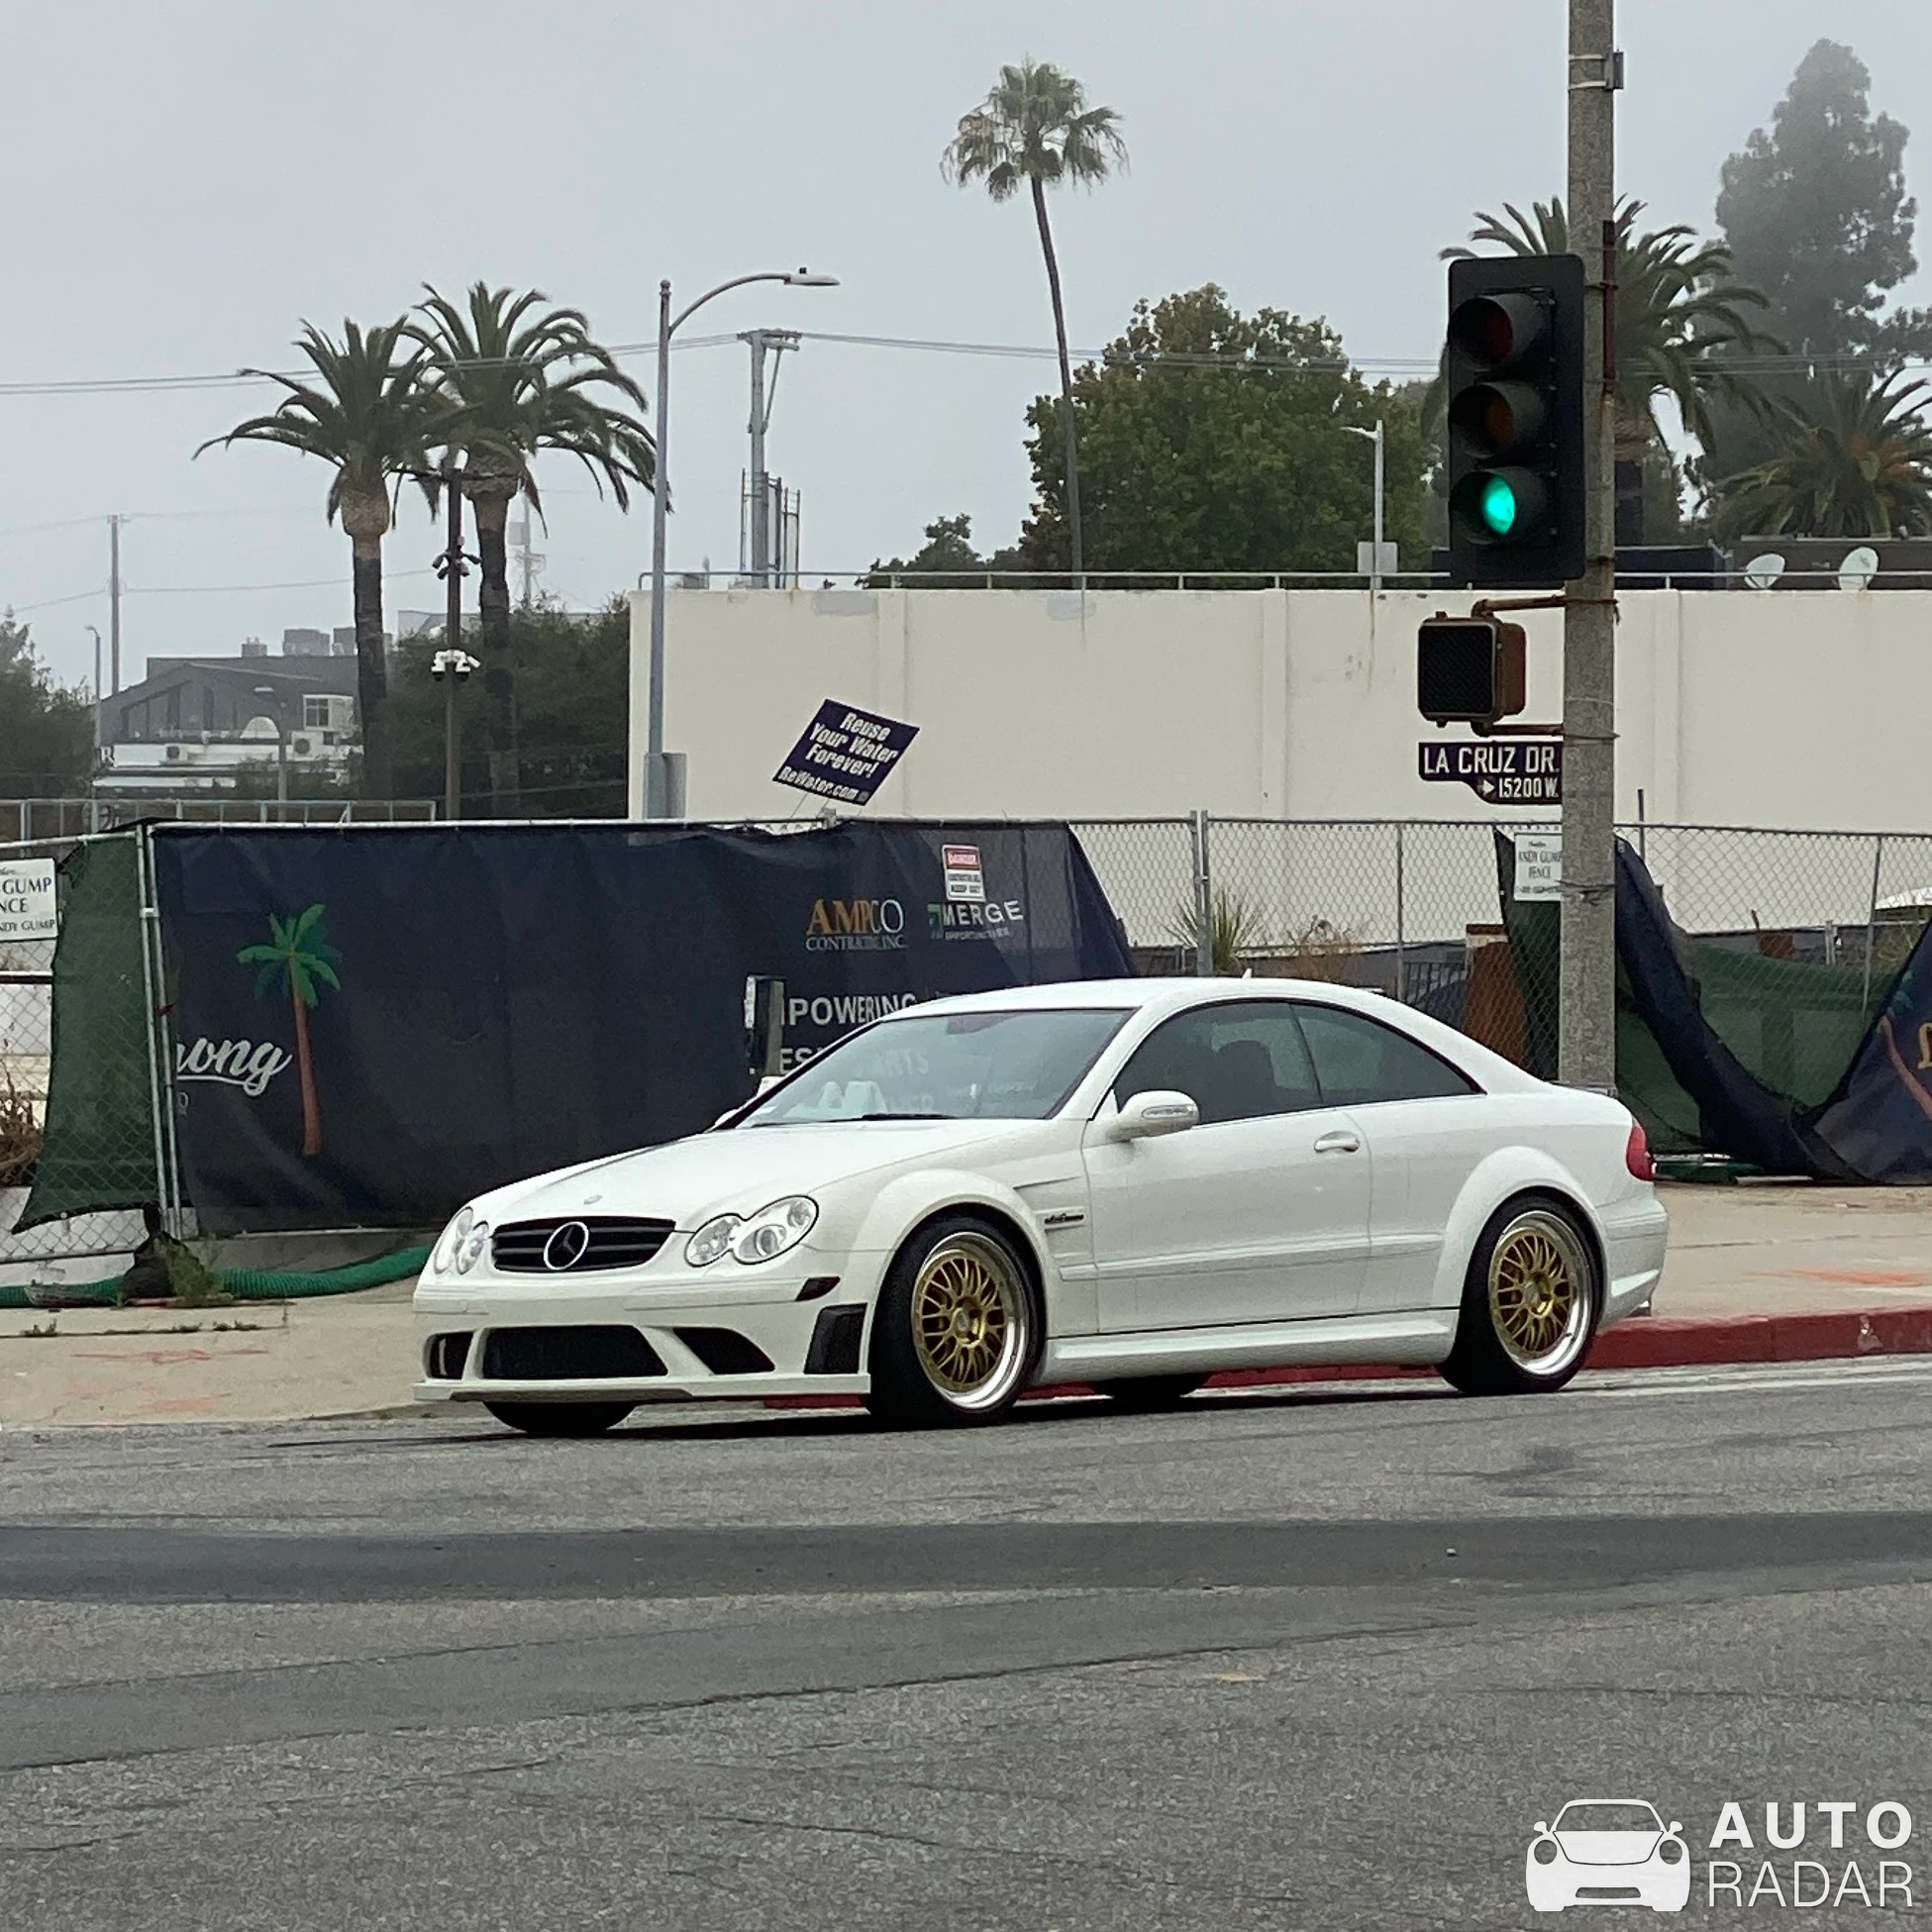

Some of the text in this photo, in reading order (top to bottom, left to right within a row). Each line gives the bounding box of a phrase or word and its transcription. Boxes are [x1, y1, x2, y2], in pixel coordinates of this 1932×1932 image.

[809, 722, 899, 763] Your Water
[840, 712, 891, 742] Reuse
[805, 743, 879, 778] Forever!
[1424, 746, 1561, 773] LA CRUZ DR.
[777, 765, 860, 800] ReWater.com
[1498, 777, 1542, 798] 15200
[2, 877, 52, 894] GUMP
[806, 899, 904, 935] AMPCO
